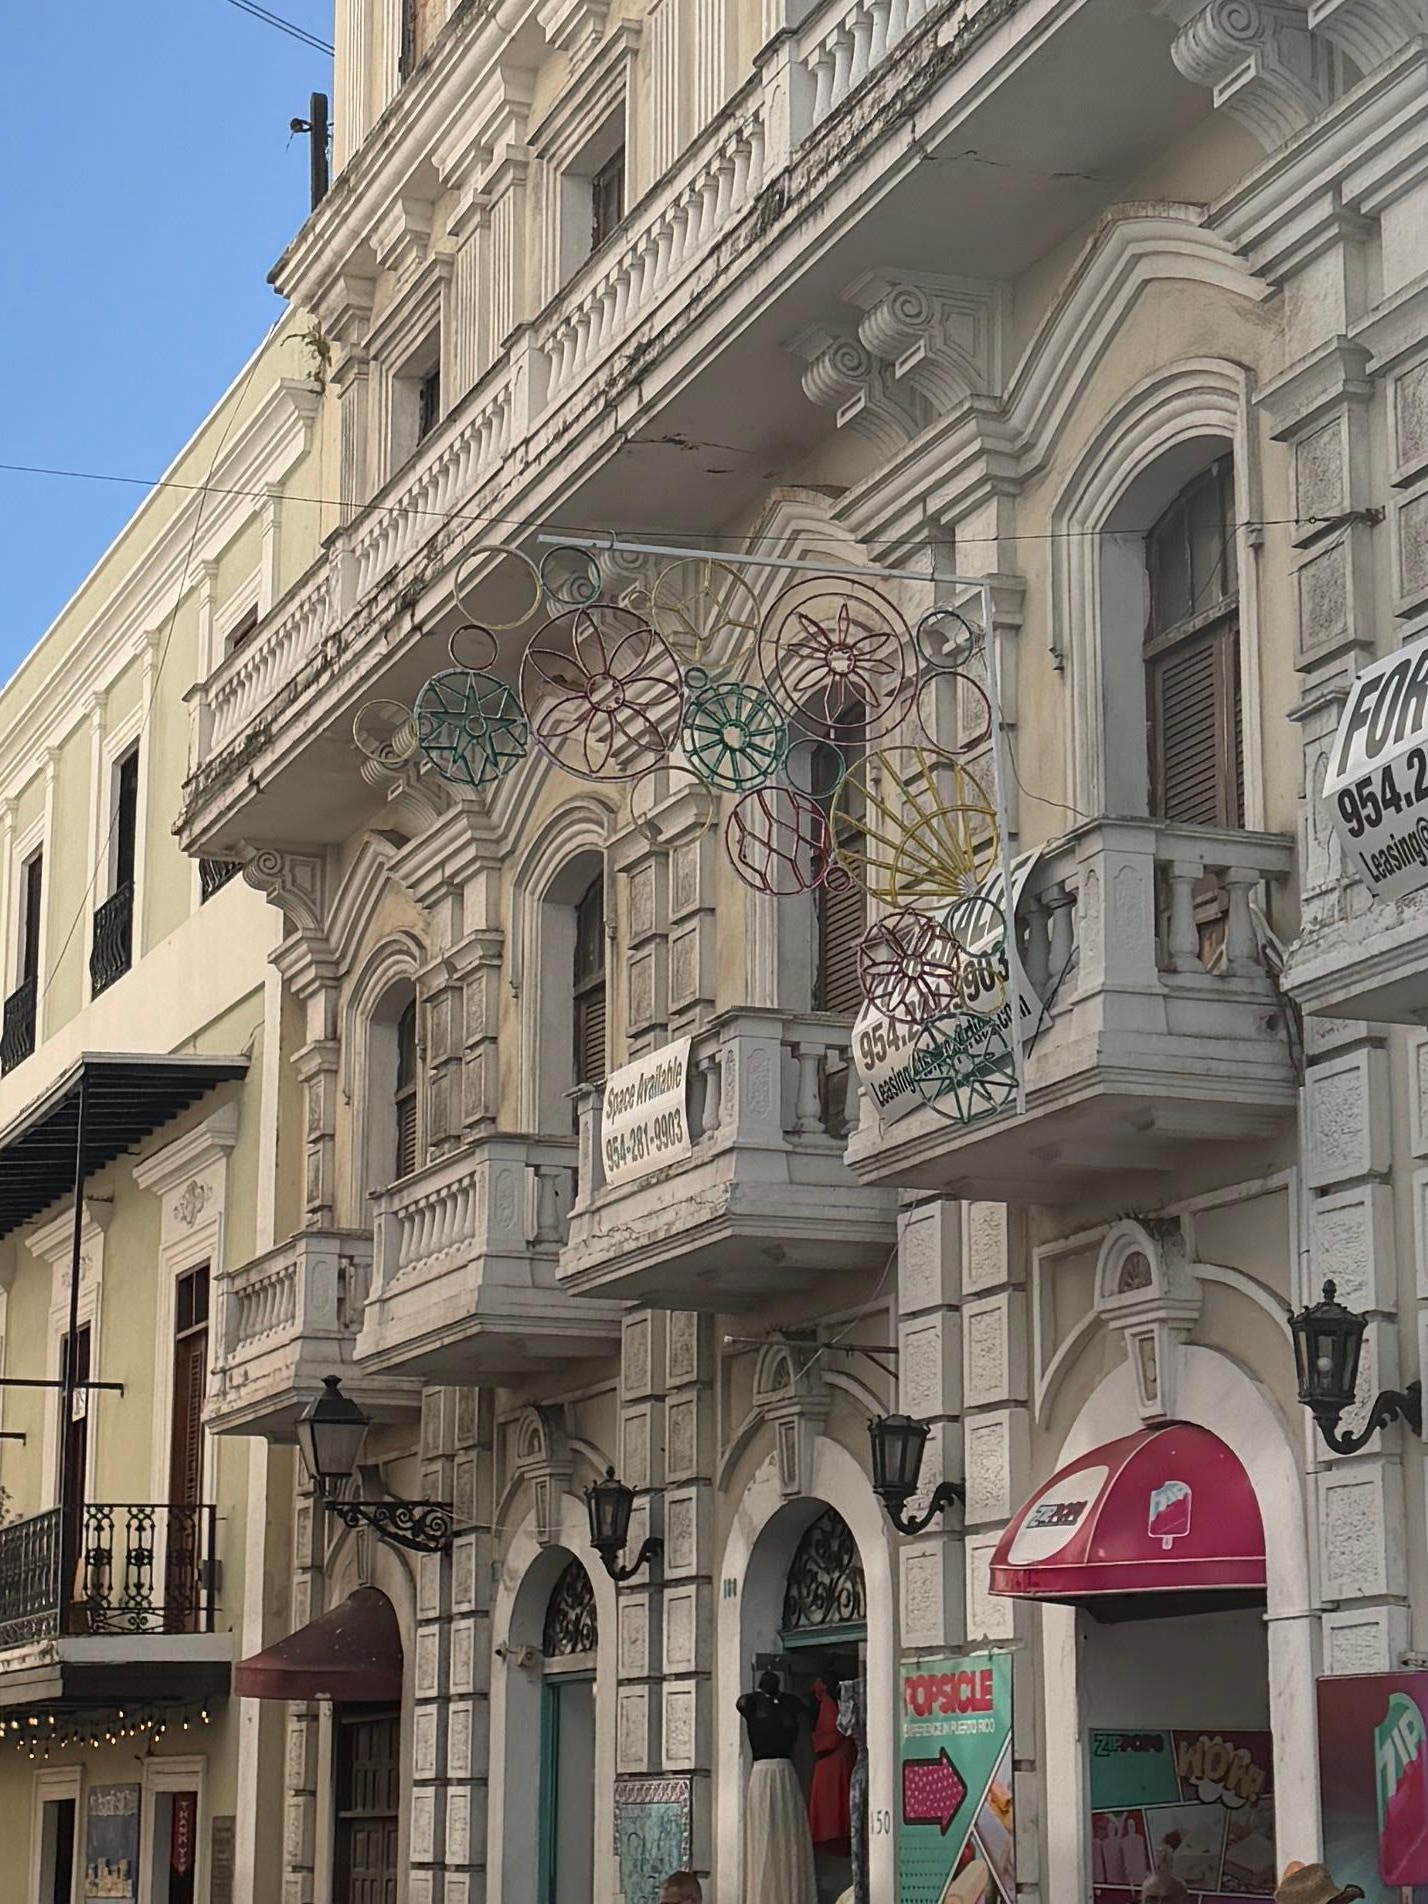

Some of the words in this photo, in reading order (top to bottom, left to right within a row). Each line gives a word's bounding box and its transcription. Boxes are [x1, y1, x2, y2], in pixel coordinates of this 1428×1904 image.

[606, 1082, 635, 1126] Space
[636, 1056, 683, 1106] Available
[606, 1108, 683, 1173] 954-281-9903
[903, 1668, 994, 1717] POPSICLE
